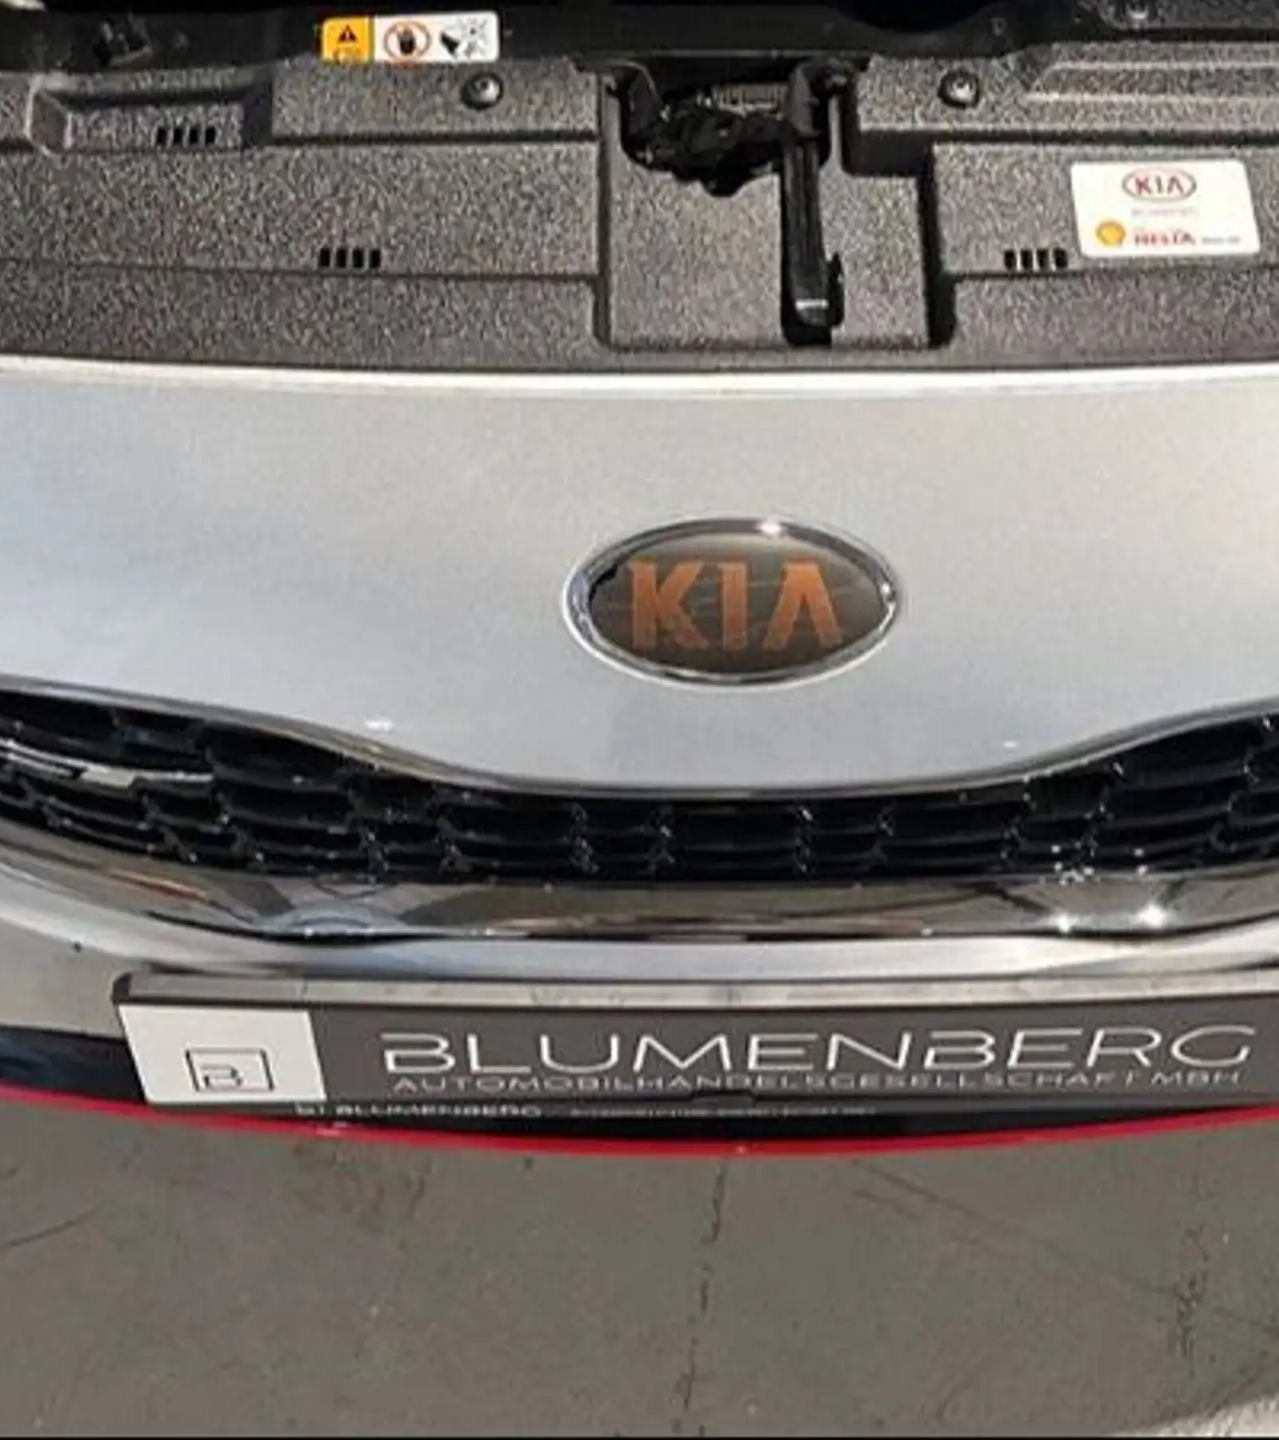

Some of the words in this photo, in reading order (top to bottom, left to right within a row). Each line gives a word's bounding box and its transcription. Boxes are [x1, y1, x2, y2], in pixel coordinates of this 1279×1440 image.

[1134, 175, 1185, 196] KIA
[627, 556, 844, 651] KIA
[380, 1025, 1255, 1074] BLUMENBERG
